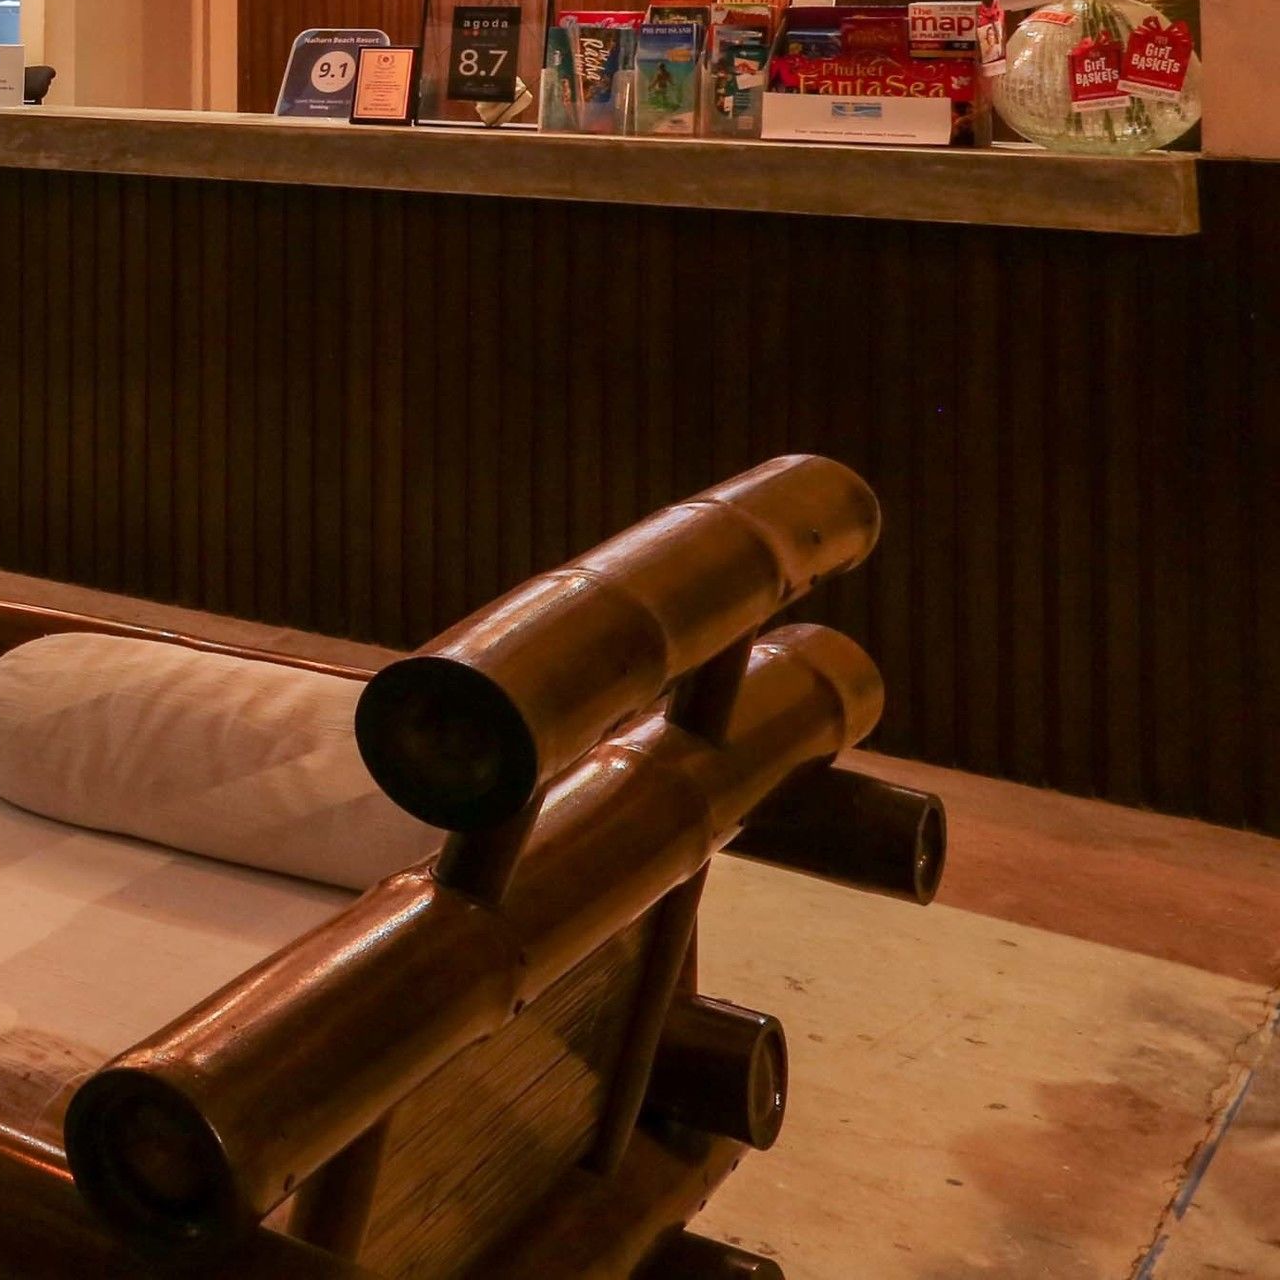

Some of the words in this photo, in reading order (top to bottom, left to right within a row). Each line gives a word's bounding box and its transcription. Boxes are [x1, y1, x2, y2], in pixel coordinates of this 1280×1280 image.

[912, 7, 932, 16] The
[463, 19, 508, 29] agoda
[911, 16, 975, 36] map
[334, 36, 355, 45] Beach
[356, 36, 380, 45] Resort
[1145, 43, 1172, 60] GIFT
[318, 62, 348, 78] 9.1
[458, 49, 509, 77] 8.7
[822, 61, 884, 77] Phuket
[1084, 56, 1106, 73] GIFT
[1131, 53, 1181, 75] BASKETS
[799, 73, 945, 97] FantaSea
[1075, 67, 1120, 87] BASKETS
